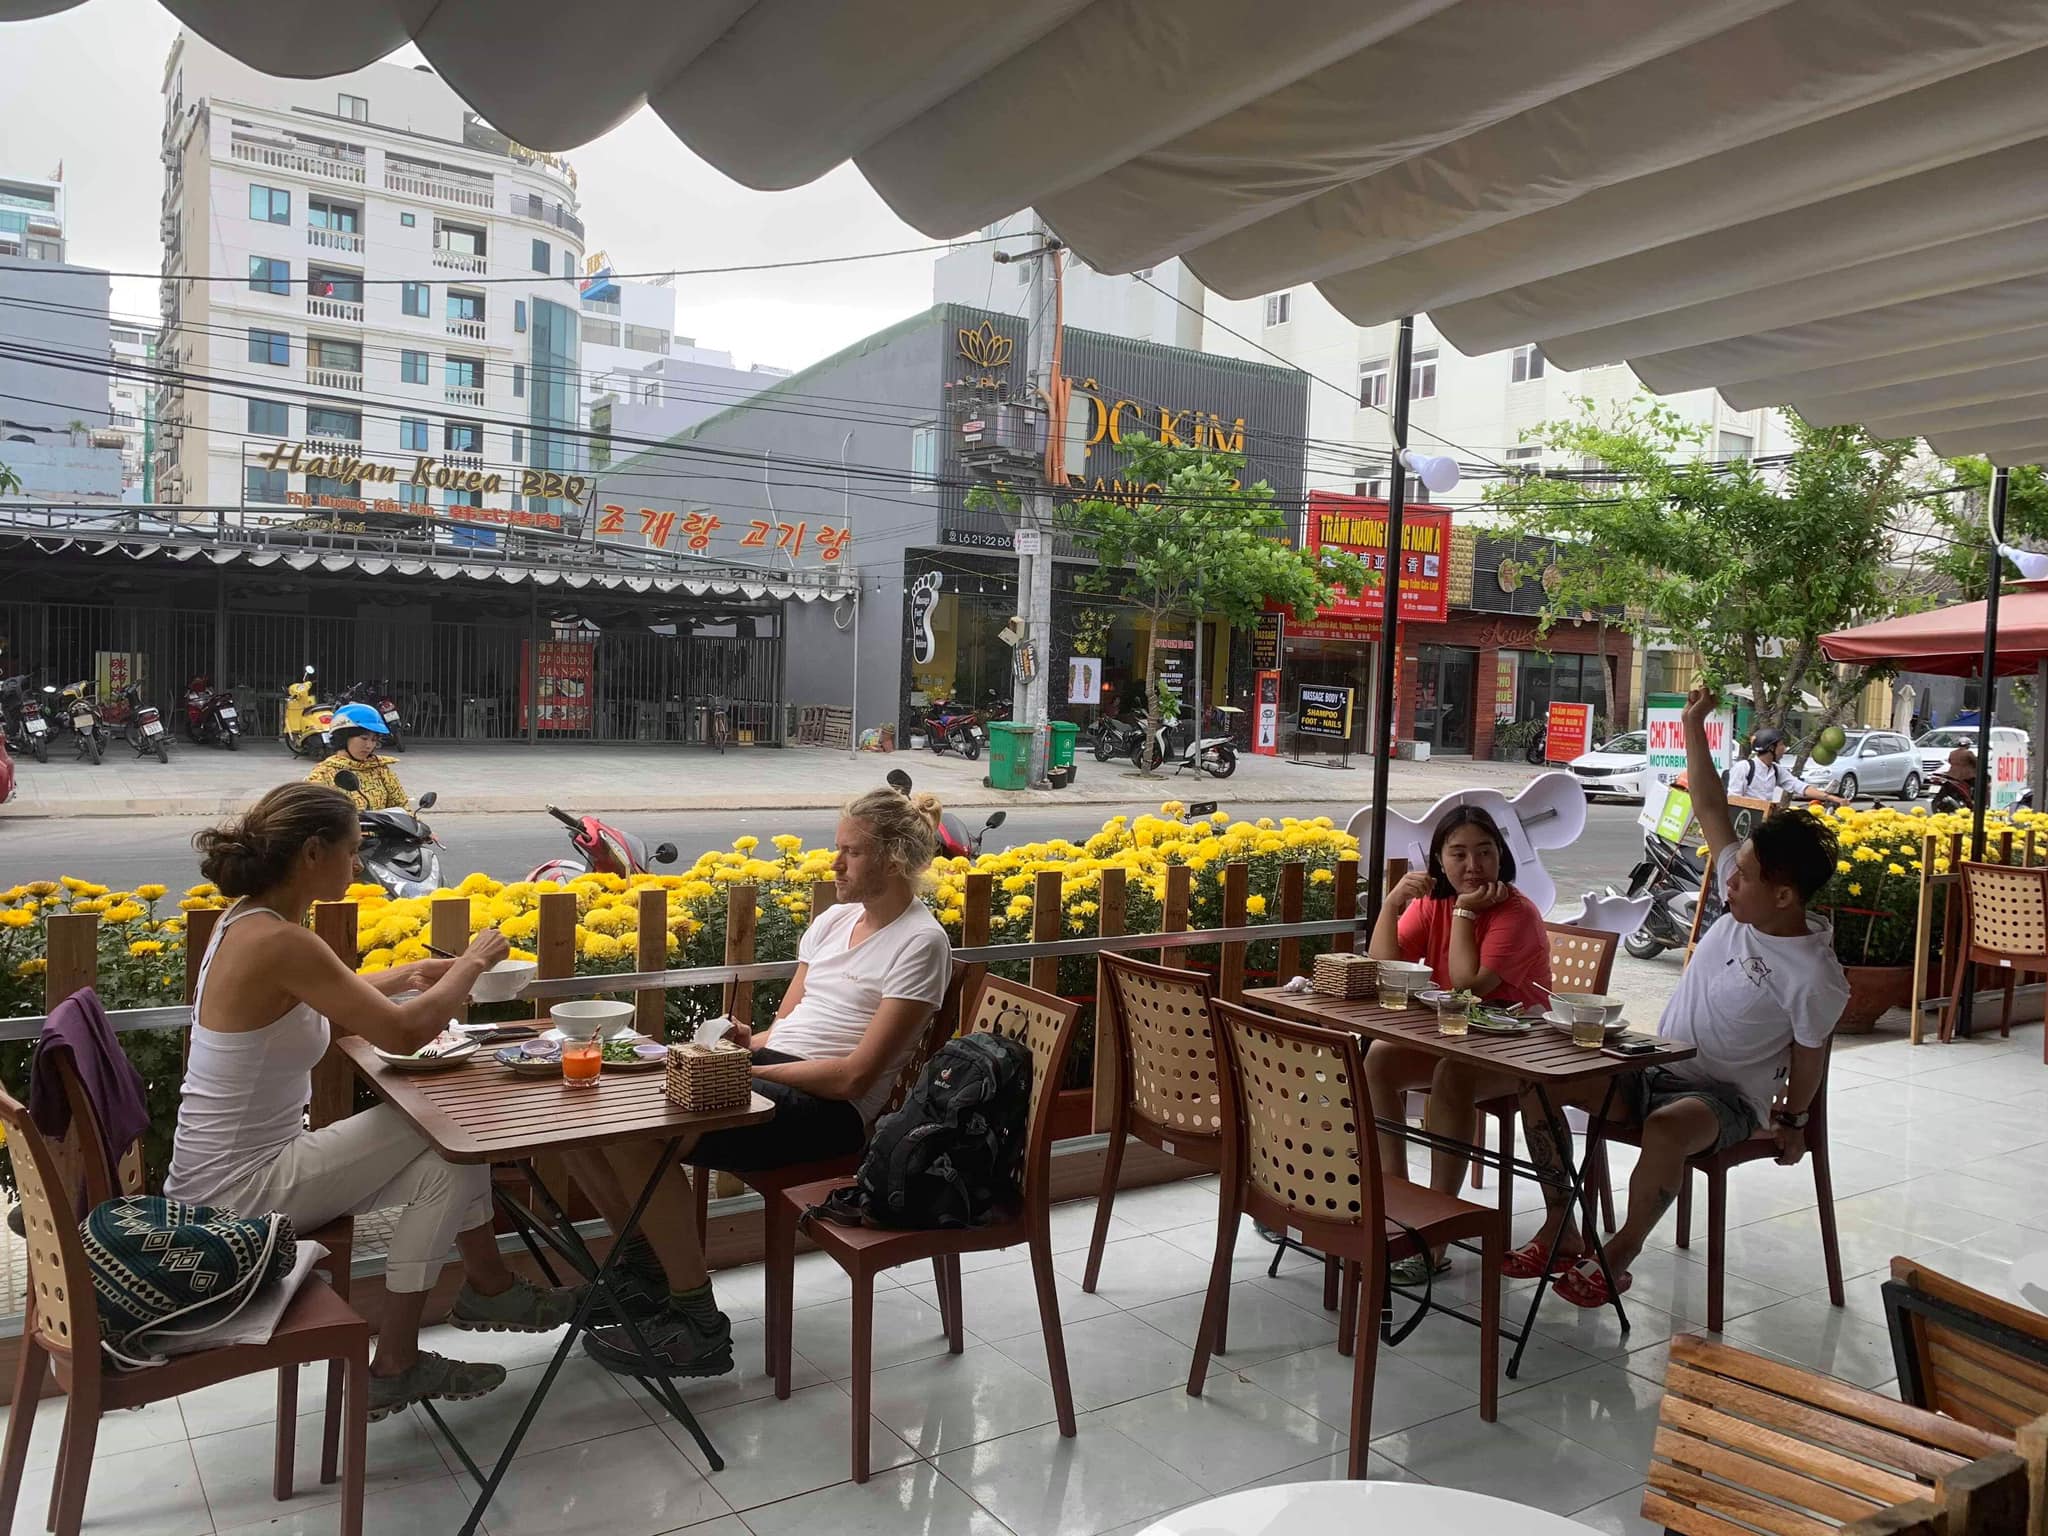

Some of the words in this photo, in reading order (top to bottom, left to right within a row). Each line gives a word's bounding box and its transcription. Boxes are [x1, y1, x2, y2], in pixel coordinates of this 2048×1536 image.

[1160, 406, 1245, 453] KIM
[257, 442, 396, 486] Haiyan
[410, 455, 502, 494] Korea
[520, 469, 586, 505] BBQ
[448, 504, 562, 528] 韩式烤肉
[597, 504, 721, 549] 조개랑
[739, 519, 852, 561] 고기랑
[971, 534, 997, 547] 21-22
[1411, 525, 1433, 553] NAM
[1301, 716, 1318, 726] FOOT
[1322, 719, 1342, 729] NAILS
[1306, 708, 1338, 719] SHAMPOO
[1650, 720, 1667, 749] CHO
[1668, 720, 1687, 750] THU
[1650, 754, 1687, 768] MOTORBIK
